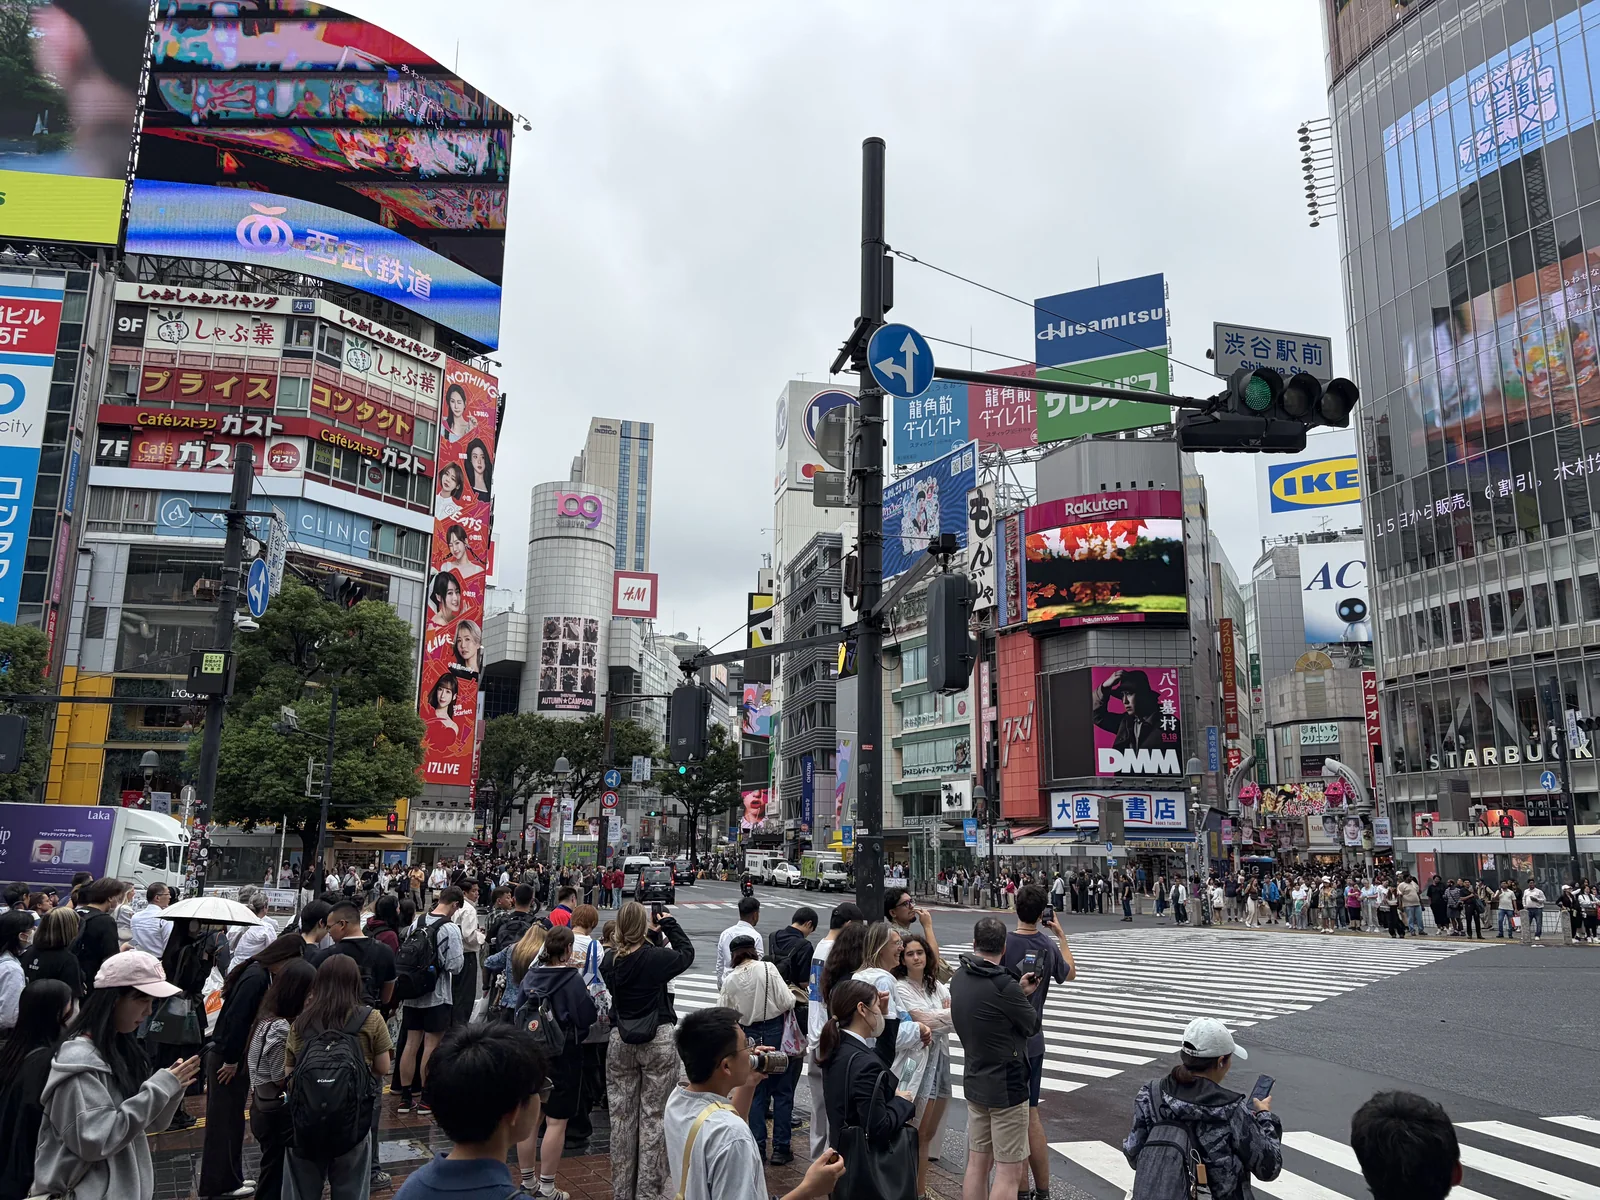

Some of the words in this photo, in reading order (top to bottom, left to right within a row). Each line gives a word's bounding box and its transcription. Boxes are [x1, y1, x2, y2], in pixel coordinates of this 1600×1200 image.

[305, 228, 433, 299] 西武鉄道
[138, 285, 279, 309] しゃぶしゃぶバイキング
[294, 301, 314, 311] 寿司
[118, 317, 143, 332] 9F
[195, 318, 274, 346] しゃぶ葉
[340, 310, 441, 362] しゃぶしゃぶバイキング
[1037, 307, 1163, 341] Hisamitsu
[1225, 332, 1322, 366] 渋谷駅前
[144, 370, 273, 400] プライス
[377, 352, 437, 394] しゃぶ葉
[446, 371, 498, 399] NOTHING
[909, 394, 953, 419] 龍角散
[985, 387, 1031, 408] 龍角散
[312, 384, 412, 436] コンタクト
[979, 404, 1037, 429] ダイレクト
[221, 413, 283, 438] ガスト
[594, 428, 617, 436] INDIGO
[903, 416, 961, 440] ダイレクト
[100, 439, 129, 456] 7F
[138, 441, 174, 455] Café
[177, 441, 255, 470] ガス
[272, 455, 296, 464] ガスト
[382, 447, 425, 475] ガスト
[554, 491, 602, 529] 109
[1065, 497, 1128, 516] Rakuten
[301, 514, 370, 545] CLINIC
[555, 519, 585, 528] SHIBUYA
[1303, 560, 1367, 591] AC
[623, 586, 647, 602] H&M
[1082, 615, 1102, 623] Rakuten
[1103, 614, 1119, 622] Vision
[427, 633, 455, 653] LIVE
[453, 708, 473, 717] Scarlett
[541, 697, 564, 705] AUTUMN
[567, 698, 593, 707] CAMPAIGN
[1158, 672, 1177, 731] 八つ墓村
[1364, 679, 1380, 745] カラオケ
[1161, 733, 1177, 741] 9.18
[1301, 734, 1338, 743] クリニック
[1310, 724, 1338, 733] れいわ
[427, 762, 460, 775] 17LIVE
[1098, 748, 1181, 774] DMM
[88, 810, 110, 820] Laka
[1057, 797, 1175, 820] 大盛書店
